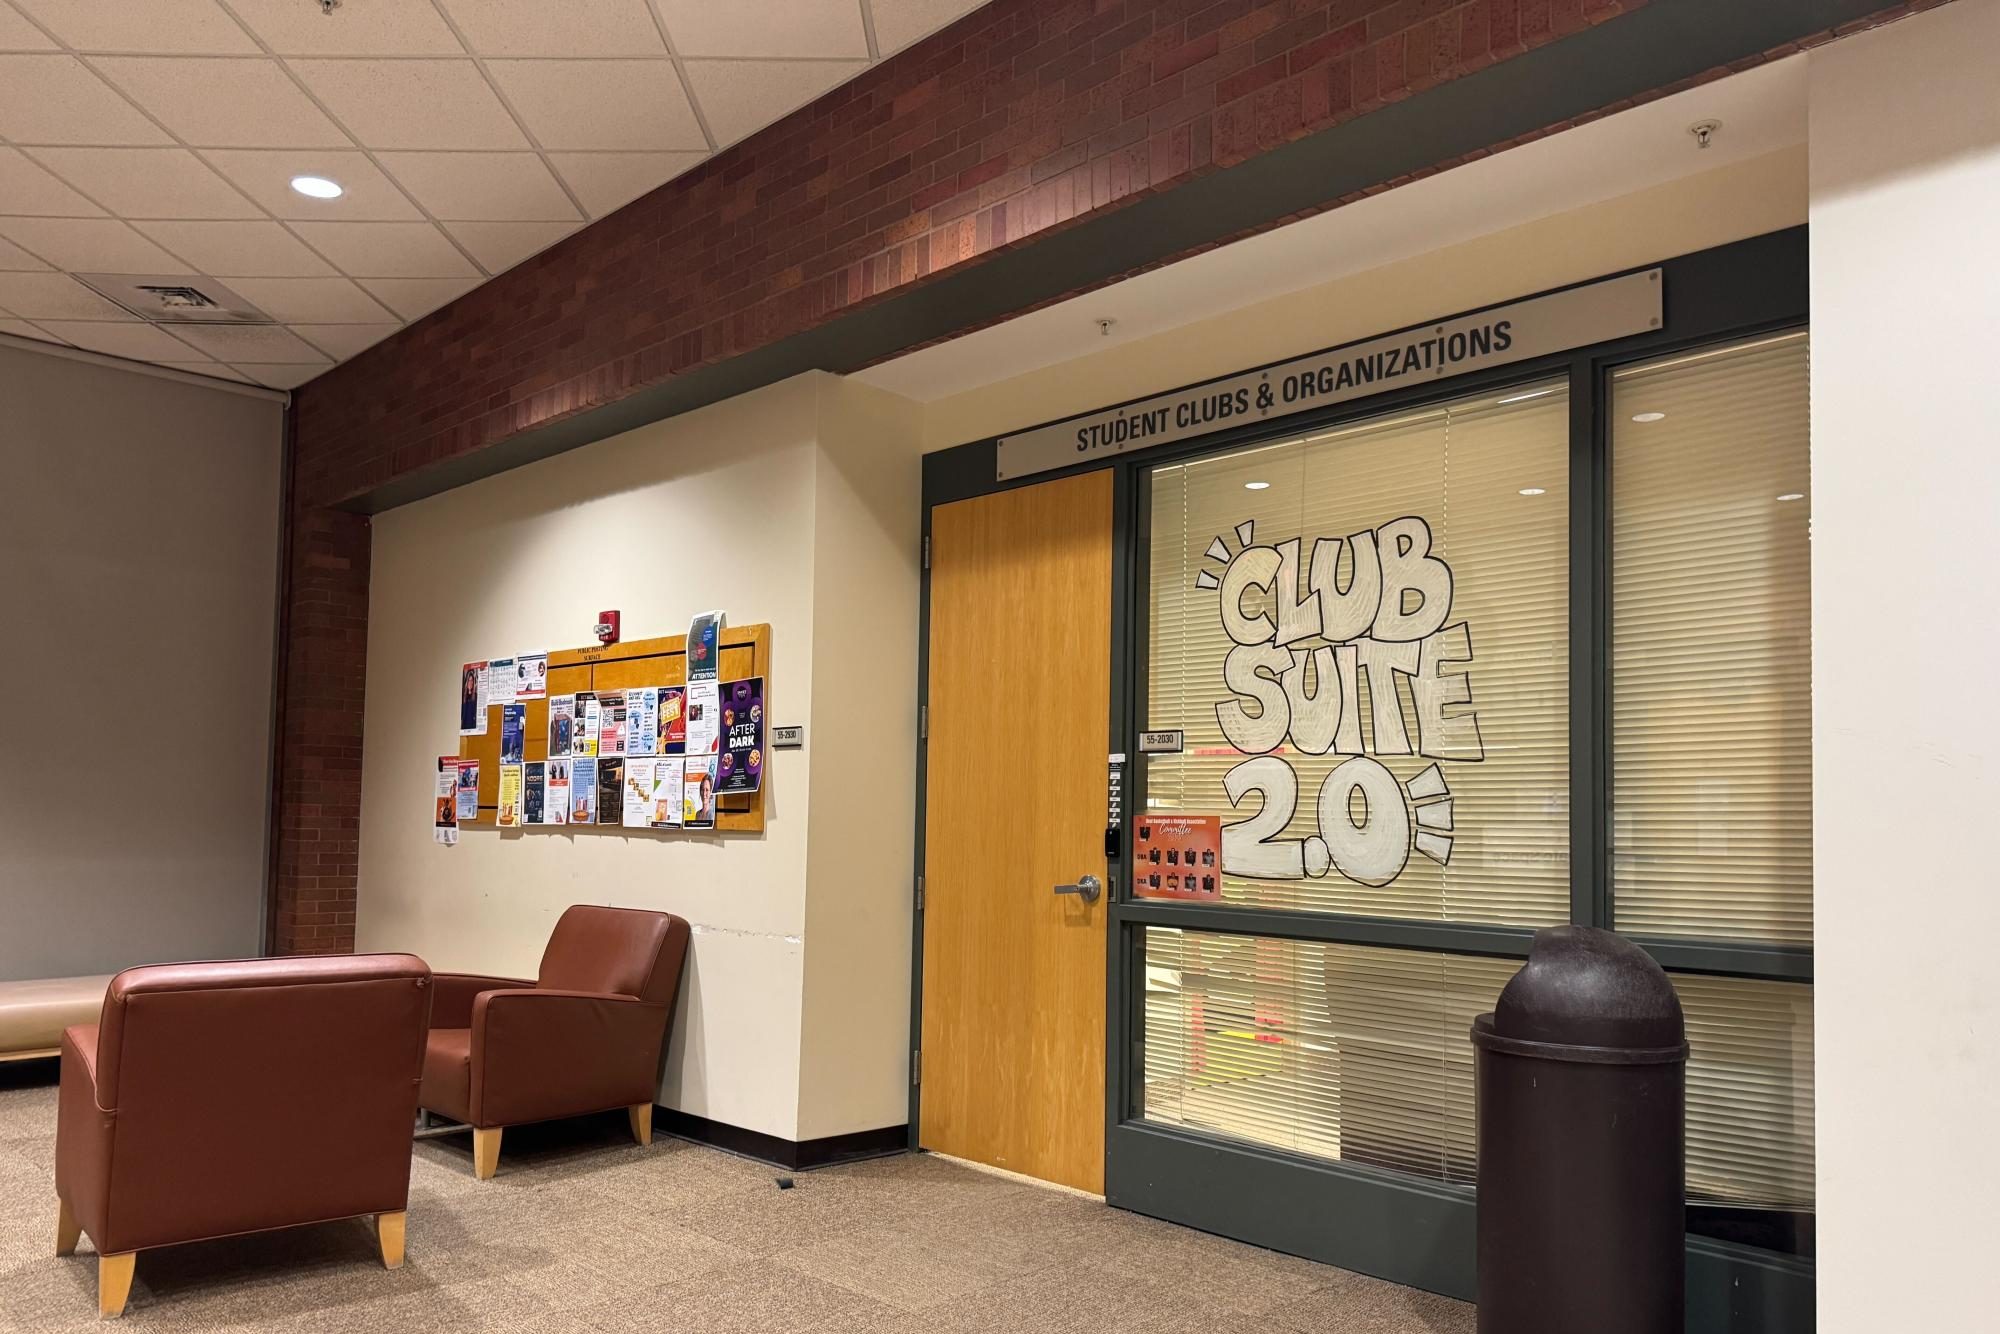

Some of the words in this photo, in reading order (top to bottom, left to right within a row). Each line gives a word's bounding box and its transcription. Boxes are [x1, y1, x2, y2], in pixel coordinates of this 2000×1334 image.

[1077, 407, 1170, 452] STUDENT
[1176, 388, 1249, 429] CLUBS
[1255, 382, 1274, 409] &
[1282, 320, 1512, 402] ORGANIZATIONS
[1220, 516, 1453, 648] CLUB
[691, 671, 717, 680] ATTENTION
[1215, 621, 1484, 761] SUITE
[729, 723, 755, 737] AFTER
[729, 734, 755, 748] DARK
[1146, 734, 1174, 744] 55-2030
[1221, 755, 1411, 887] 2.0
[1159, 822, 1192, 835] Committee
